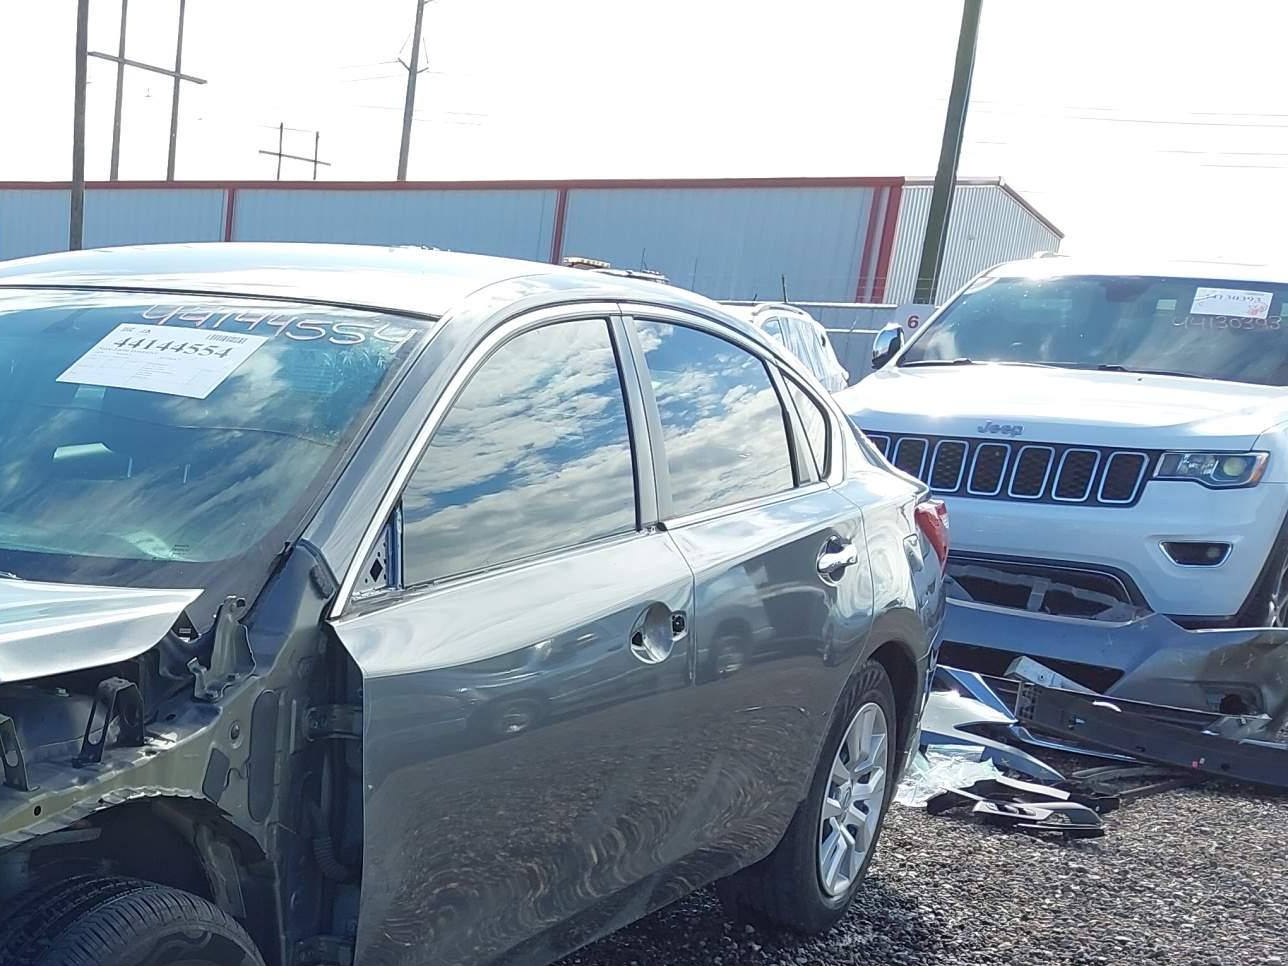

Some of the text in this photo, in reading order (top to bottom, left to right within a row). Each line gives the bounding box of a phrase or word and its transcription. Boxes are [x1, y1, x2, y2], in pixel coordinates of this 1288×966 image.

[907, 315, 919, 329] 6
[113, 336, 233, 359] 44144554
[977, 419, 1024, 438] Jeep
